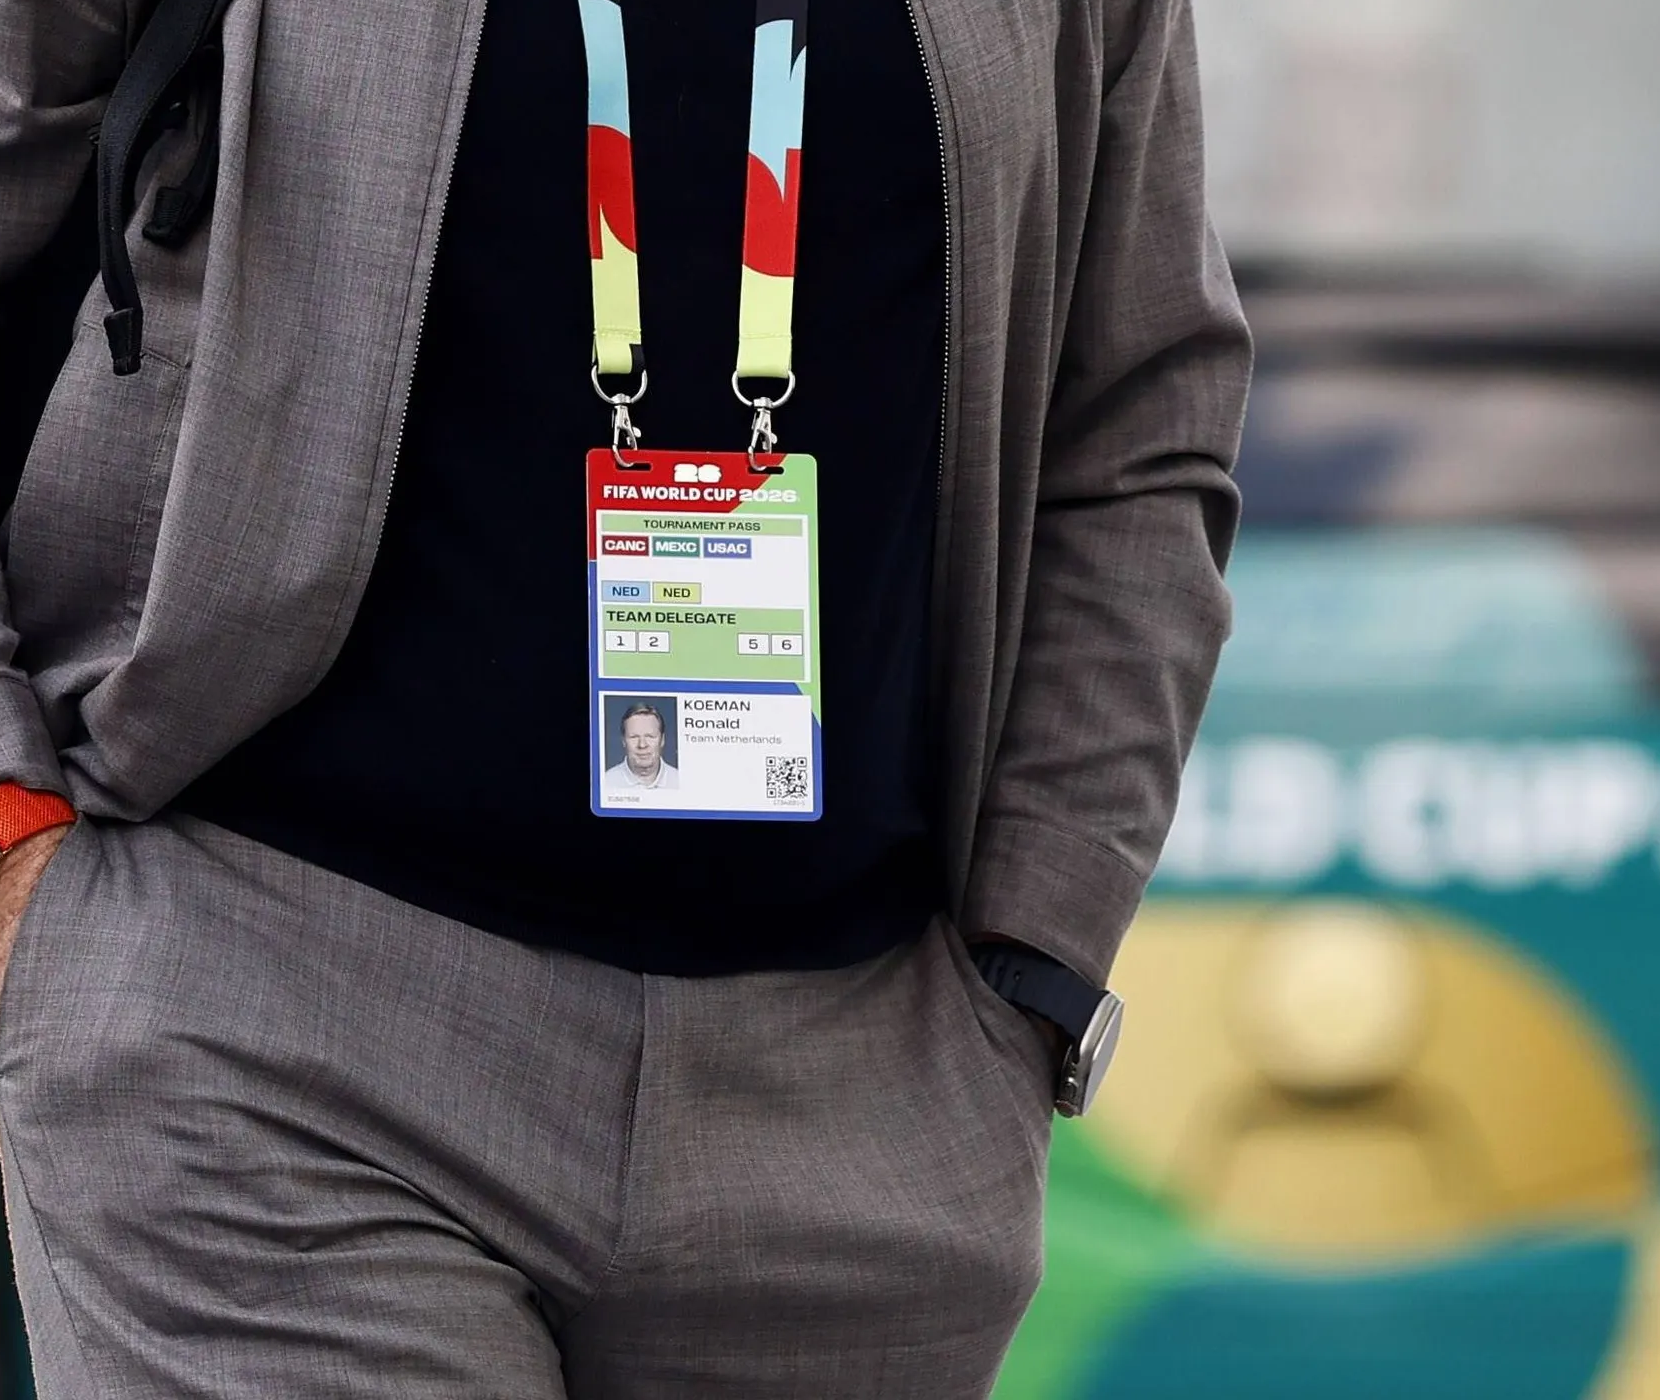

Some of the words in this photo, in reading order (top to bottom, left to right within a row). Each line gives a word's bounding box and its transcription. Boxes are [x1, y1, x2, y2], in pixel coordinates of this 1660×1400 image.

[603, 485, 639, 500] FIFA
[640, 486, 701, 501] WORLD
[703, 487, 737, 502] CUP
[739, 488, 797, 503] 2026
[643, 519, 726, 531] TOURNAMENT
[728, 521, 761, 533] PASS
[604, 540, 647, 552] CANC
[655, 541, 697, 553] MEXC
[707, 542, 748, 554] USAC
[612, 586, 640, 597] NED
[663, 587, 691, 598] NED
[606, 610, 652, 623] TEAM
[655, 612, 737, 625] DELEGATE
[616, 635, 625, 647] 1
[649, 636, 659, 647] 2
[748, 638, 758, 650] 5
[781, 639, 792, 651] 6
[684, 699, 751, 712] KOEMAN
[684, 717, 740, 730] Ronald
[684, 733, 715, 744] Team
[716, 734, 783, 745] Netherlands
[1353, 736, 1656, 890] CUP
